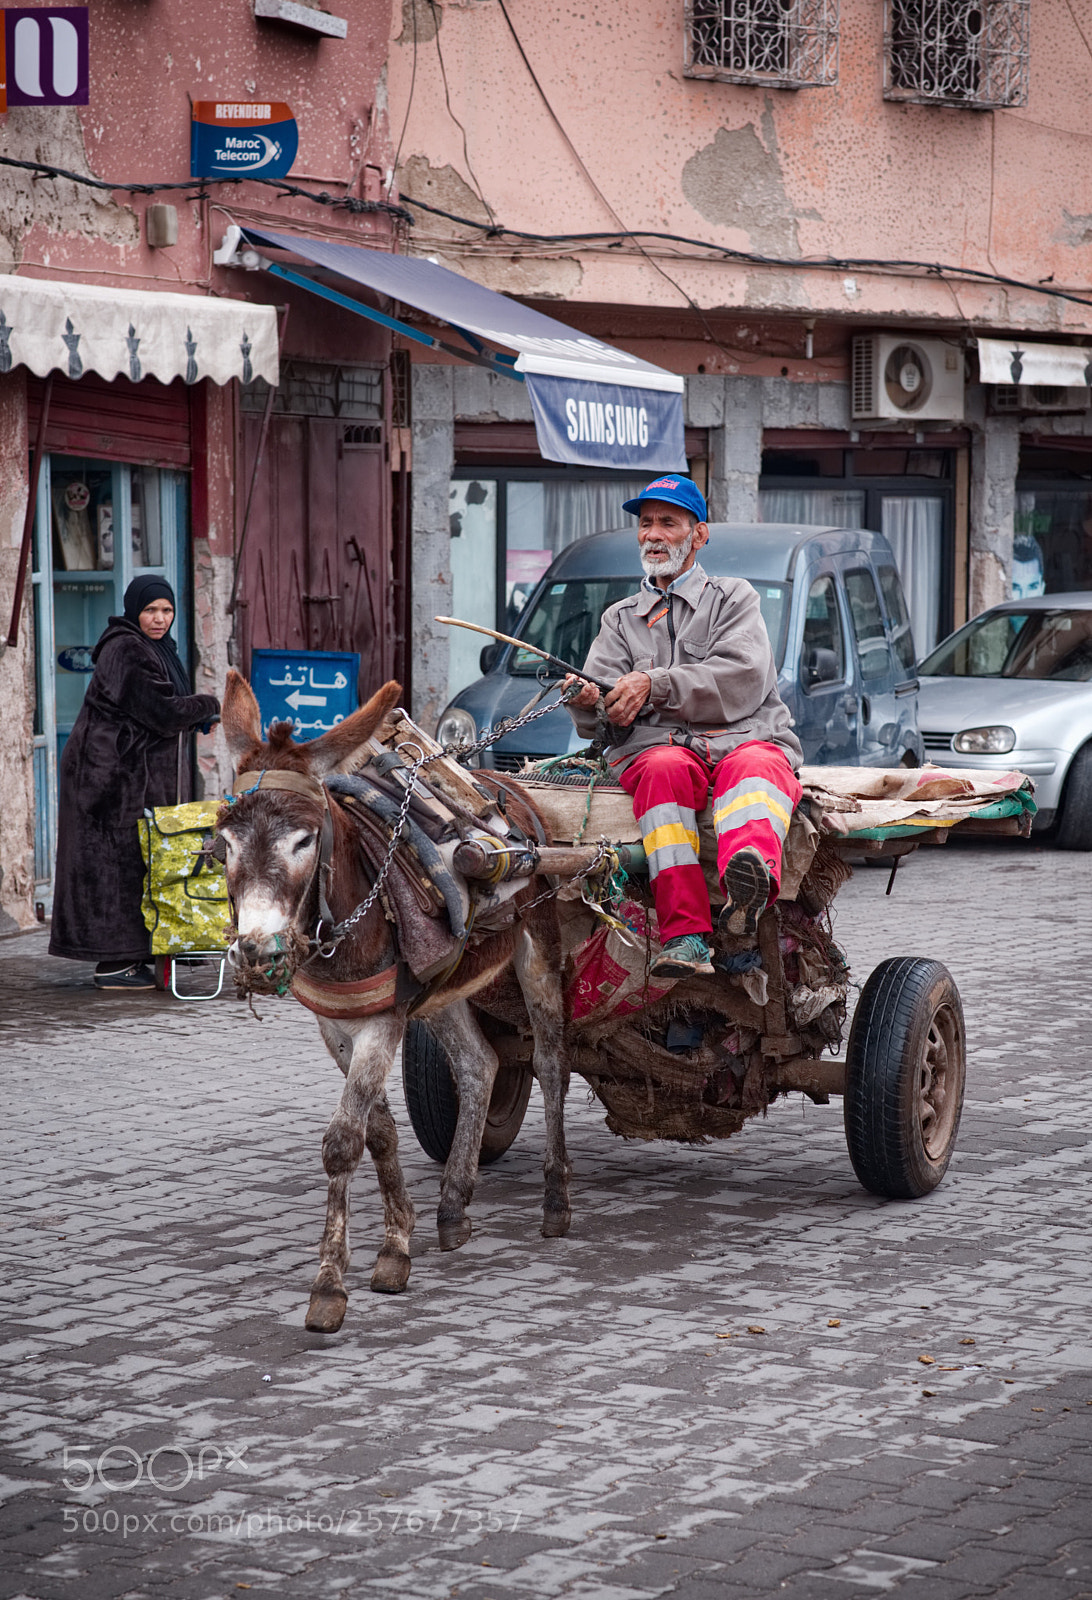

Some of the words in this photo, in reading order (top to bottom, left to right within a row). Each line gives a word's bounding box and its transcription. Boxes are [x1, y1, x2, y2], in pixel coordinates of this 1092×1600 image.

[215, 103, 272, 119] REVENDEUR
[225, 137, 261, 149] Maroc
[214, 149, 261, 161] Telecom
[565, 398, 649, 448] SAMSUNG
[269, 664, 348, 689] هاتف
